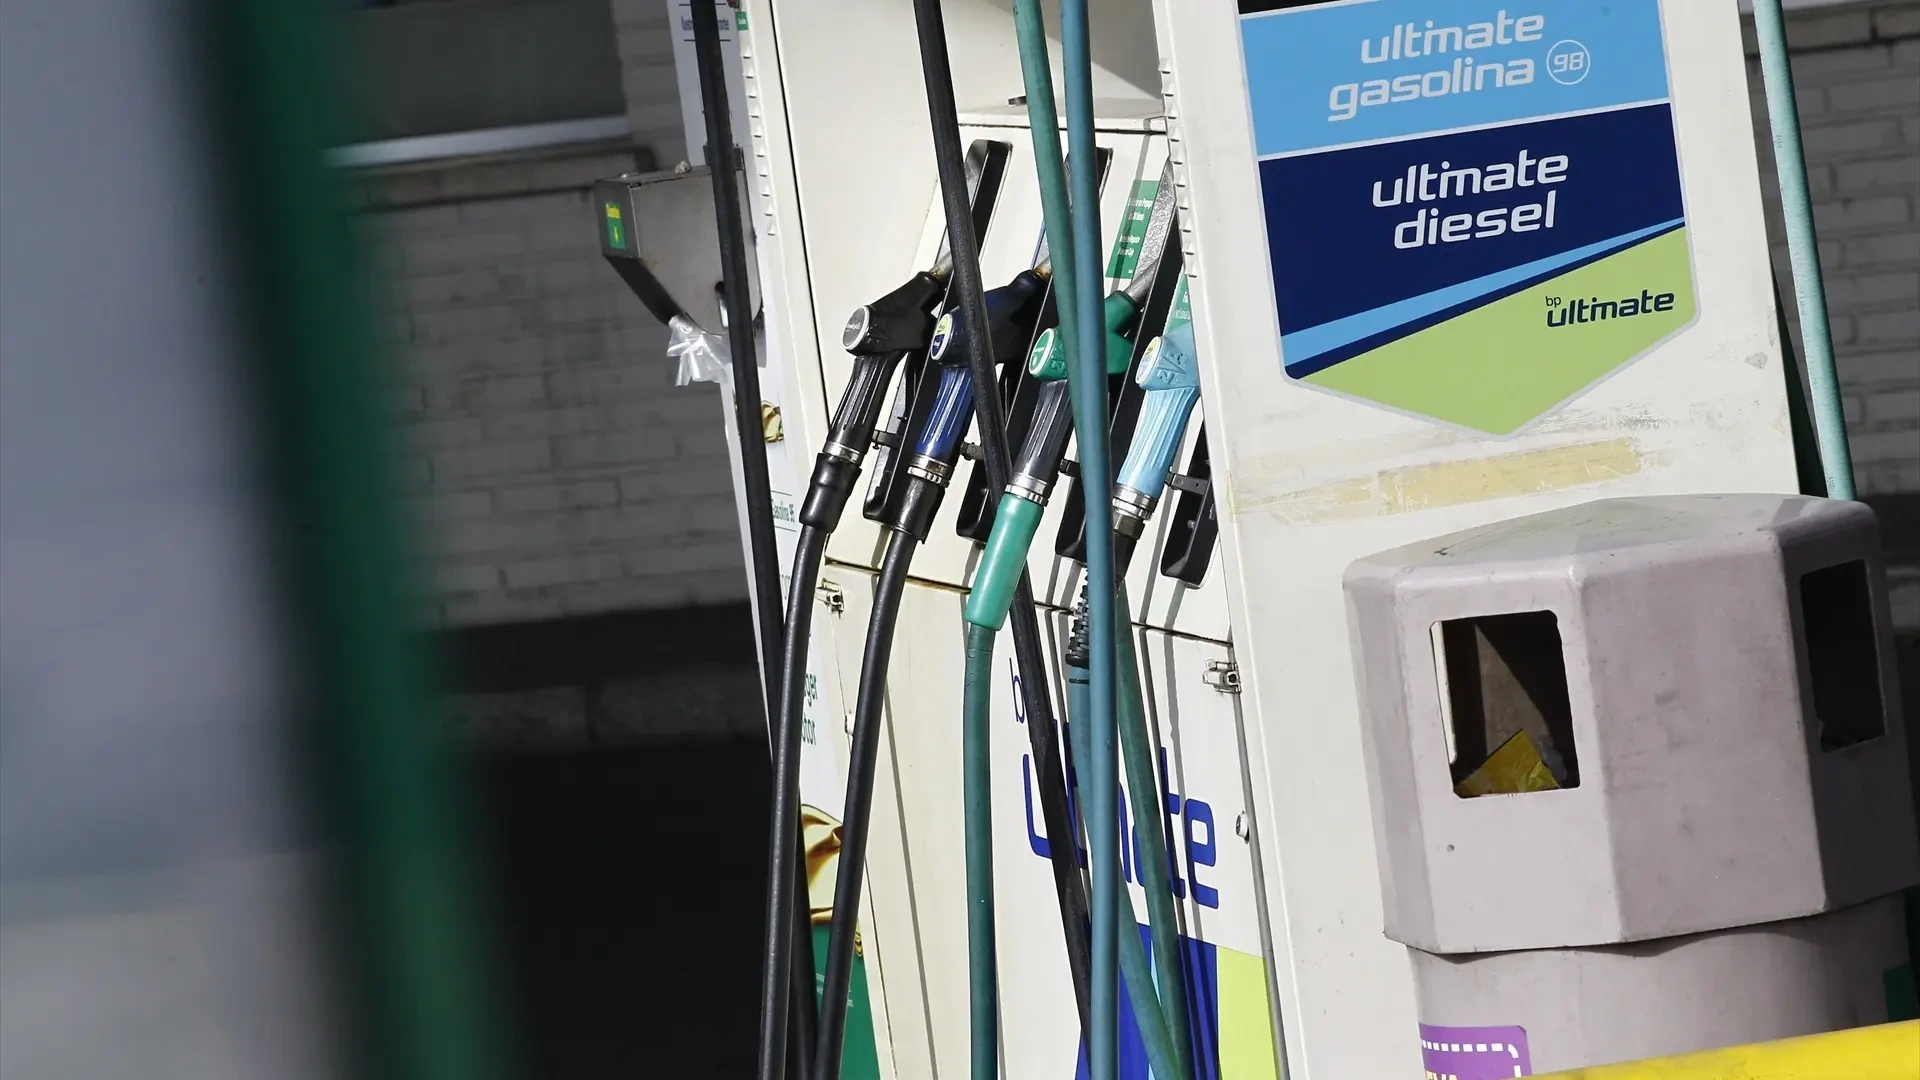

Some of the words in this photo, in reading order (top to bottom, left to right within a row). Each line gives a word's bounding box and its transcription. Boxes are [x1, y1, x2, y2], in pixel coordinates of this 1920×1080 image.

[1361, 10, 1545, 64] ultimate
[1328, 58, 1535, 121] gasolina
[1553, 53, 1584, 72] 98
[1372, 149, 1569, 208] ultimate
[1394, 190, 1557, 250] diesel
[1545, 295, 1562, 309] bp
[1546, 289, 1675, 328] ultimate
